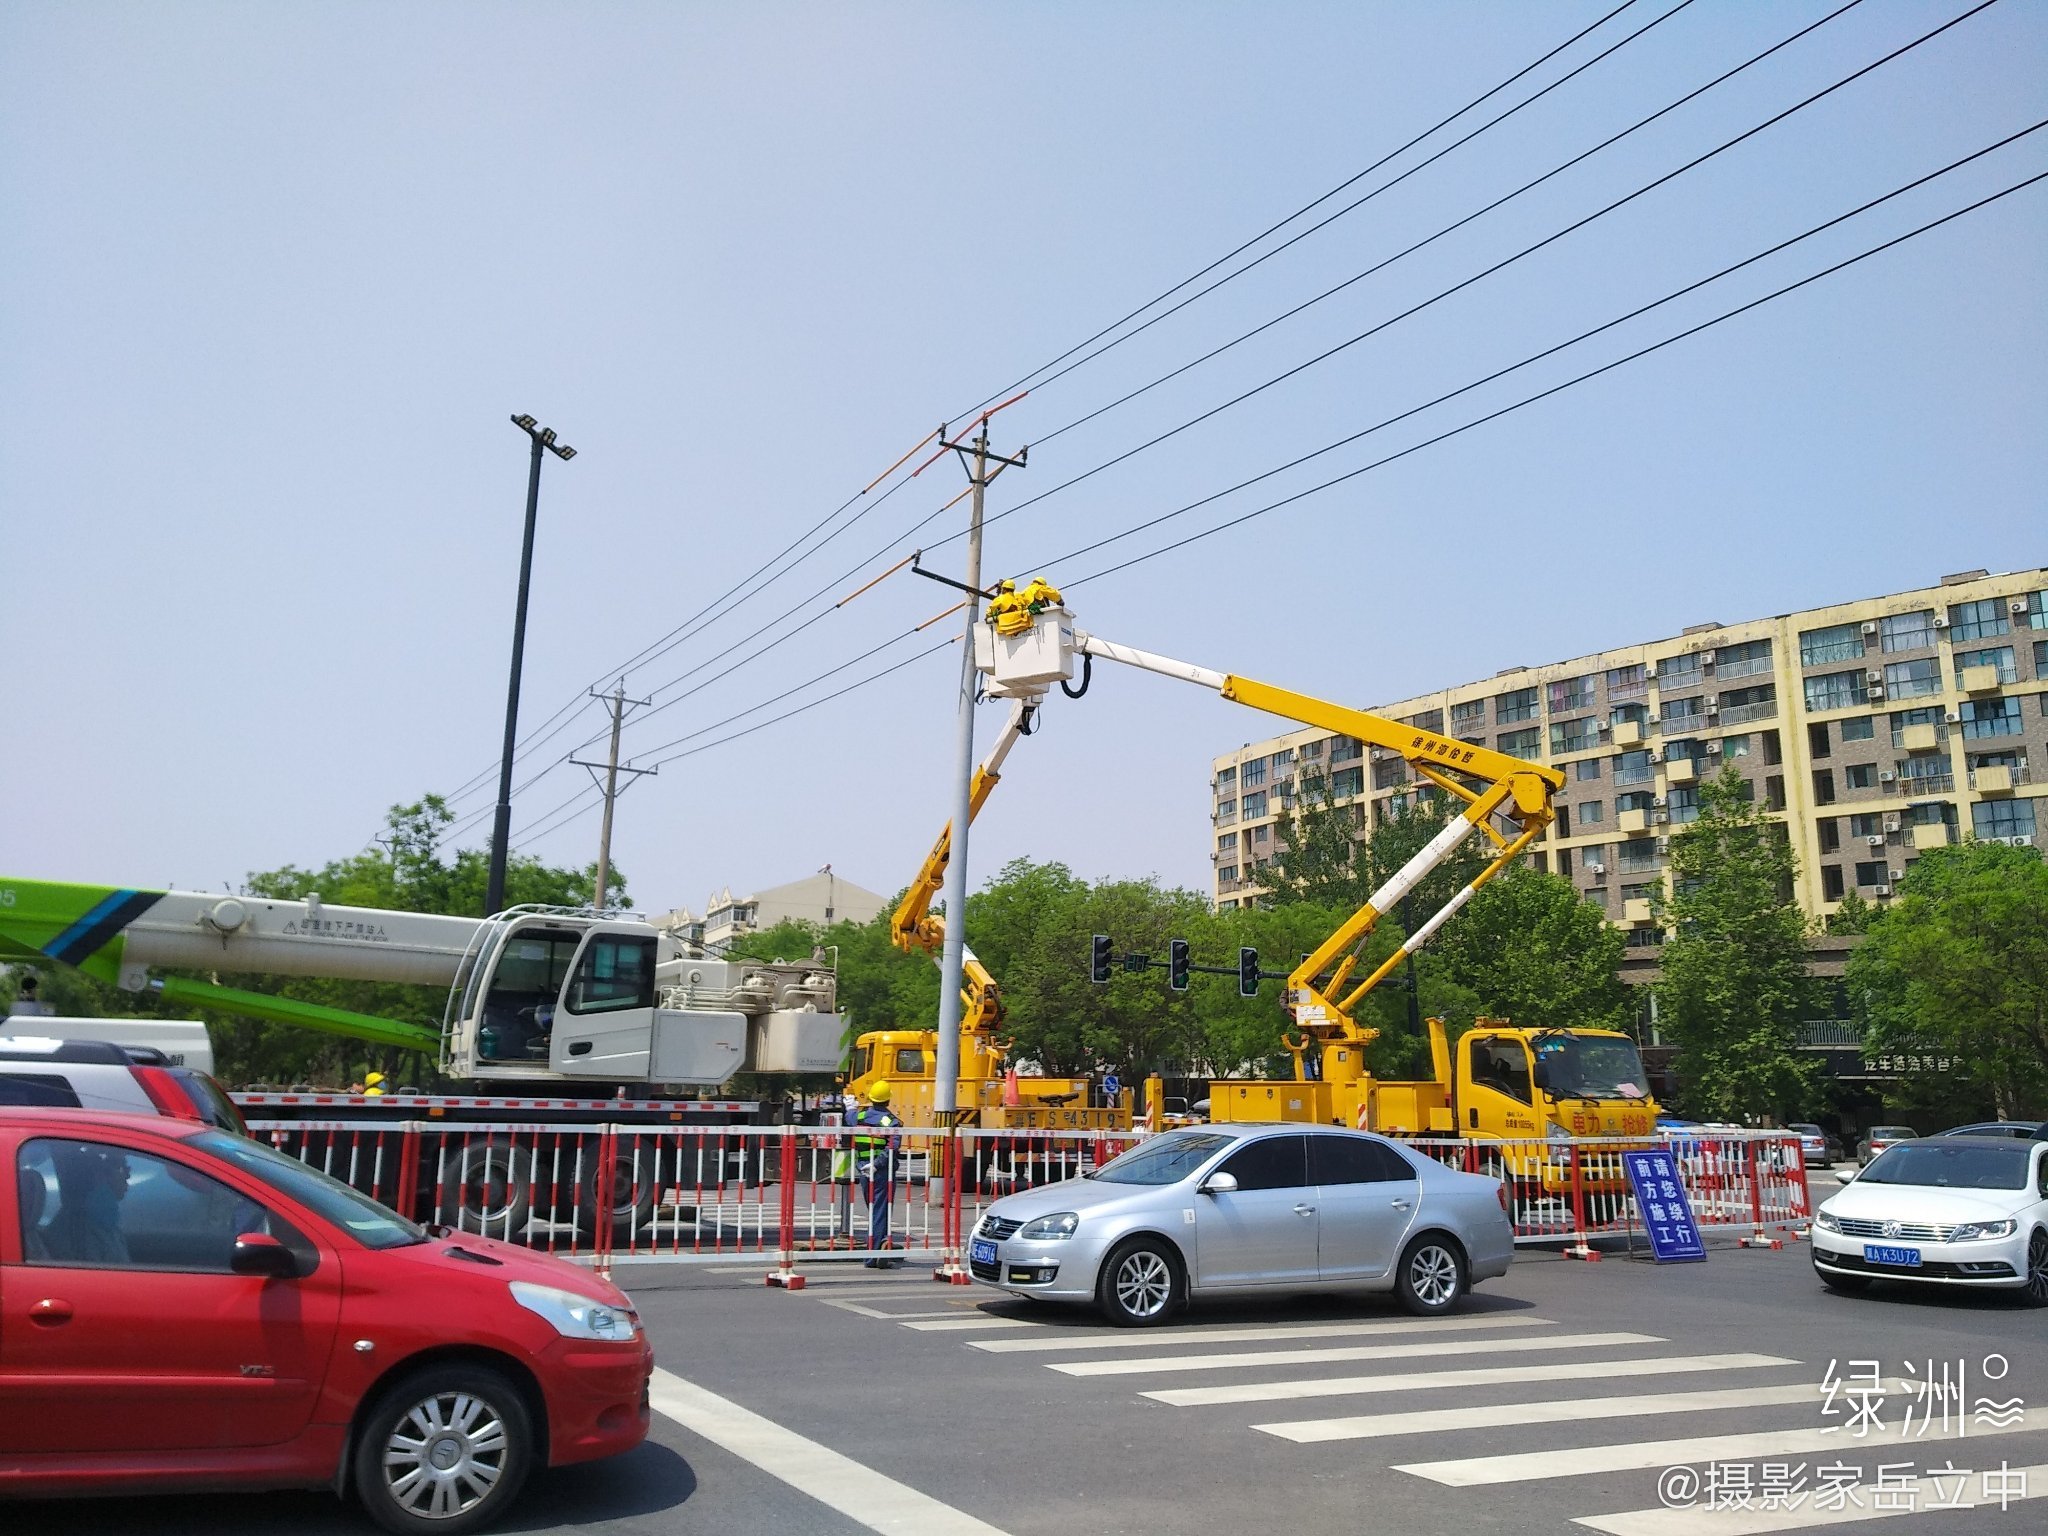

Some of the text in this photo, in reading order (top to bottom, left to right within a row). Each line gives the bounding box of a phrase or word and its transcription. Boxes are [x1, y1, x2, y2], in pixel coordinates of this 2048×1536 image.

[1411, 736, 1475, 763] 徐州海伦哲
[1573, 1112, 1600, 1135] 电力
[1635, 1158, 1675, 1244] 前方施工
[1653, 1157, 1692, 1244] 请您绕行
